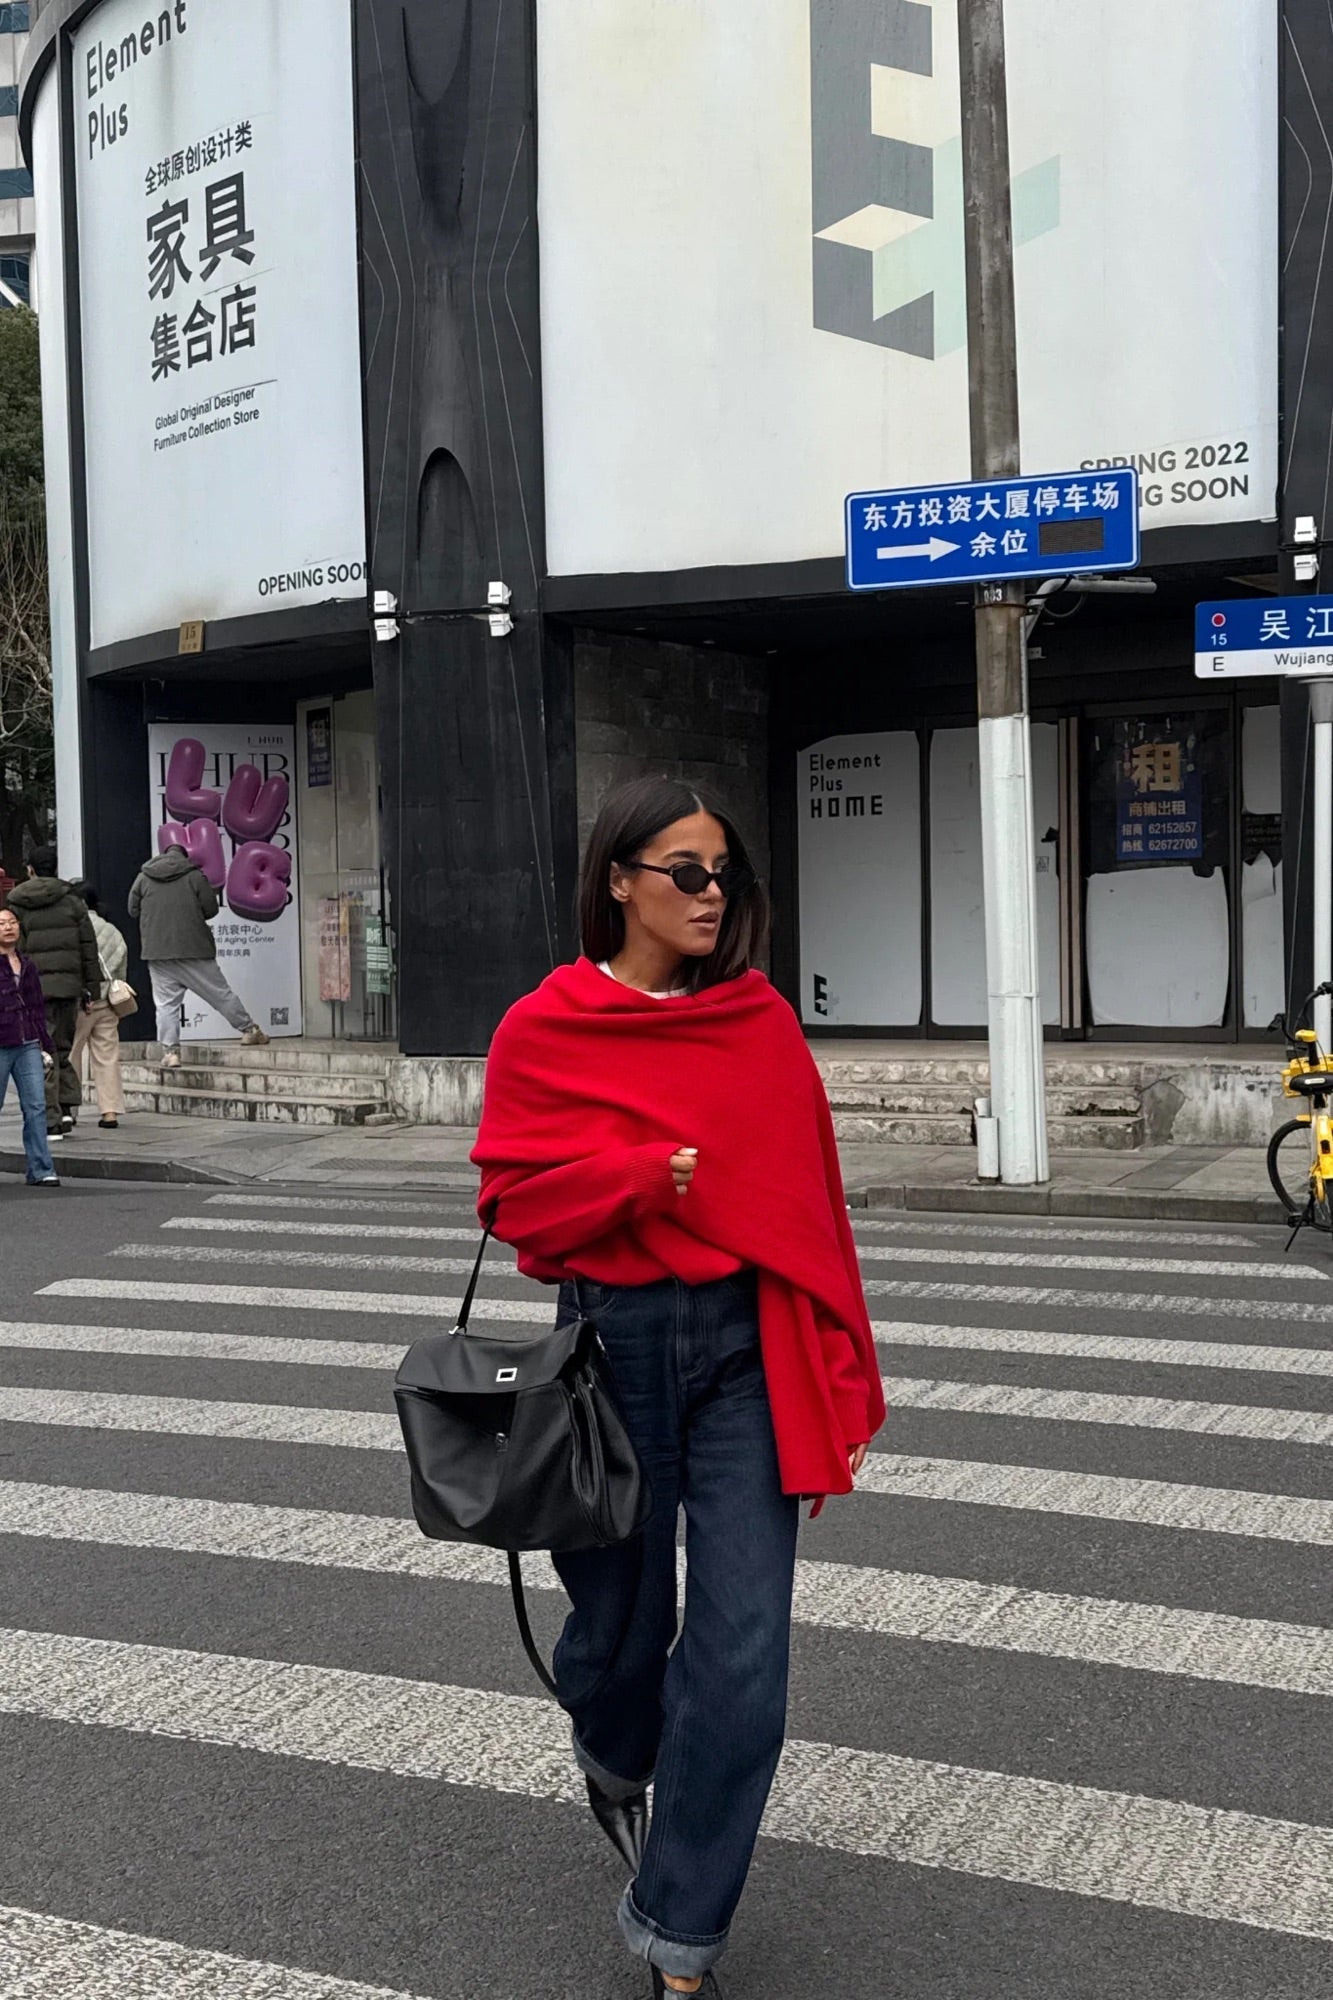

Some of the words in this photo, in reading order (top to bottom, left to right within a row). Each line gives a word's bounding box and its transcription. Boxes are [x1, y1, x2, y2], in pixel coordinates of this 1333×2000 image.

[87, 0, 186, 100] Element
[88, 102, 128, 160] Plus
[145, 120, 253, 196] 全球原创设计类
[147, 171, 256, 301] 家具
[150, 284, 256, 382] 集合店
[155, 410, 179, 430] Global
[180, 398, 212, 420] Original
[214, 388, 255, 410] Designer
[154, 431, 187, 452] Furniture
[188, 417, 231, 439] Collection
[233, 408, 260, 426] Store
[1185, 441, 1249, 470] 2022
[1171, 475, 1249, 504] SOON
[863, 481, 1120, 532] 东方投资大厦停车场
[969, 529, 1029, 558] 余位
[258, 568, 323, 596] OPENING
[1211, 633, 1228, 646] 15
[1213, 656, 1225, 672] E
[1274, 653, 1333, 668] Wujiang
[809, 753, 882, 772] Element
[1131, 742, 1182, 793] 租
[810, 775, 843, 792] Plus
[811, 795, 882, 818] HOME
[1129, 800, 1186, 817] 商铺出租
[1148, 821, 1198, 835] 62152657
[1148, 838, 1198, 851] 62672700
[209, 925, 263, 936] 抗衰中心
[224, 936, 247, 945] Aging
